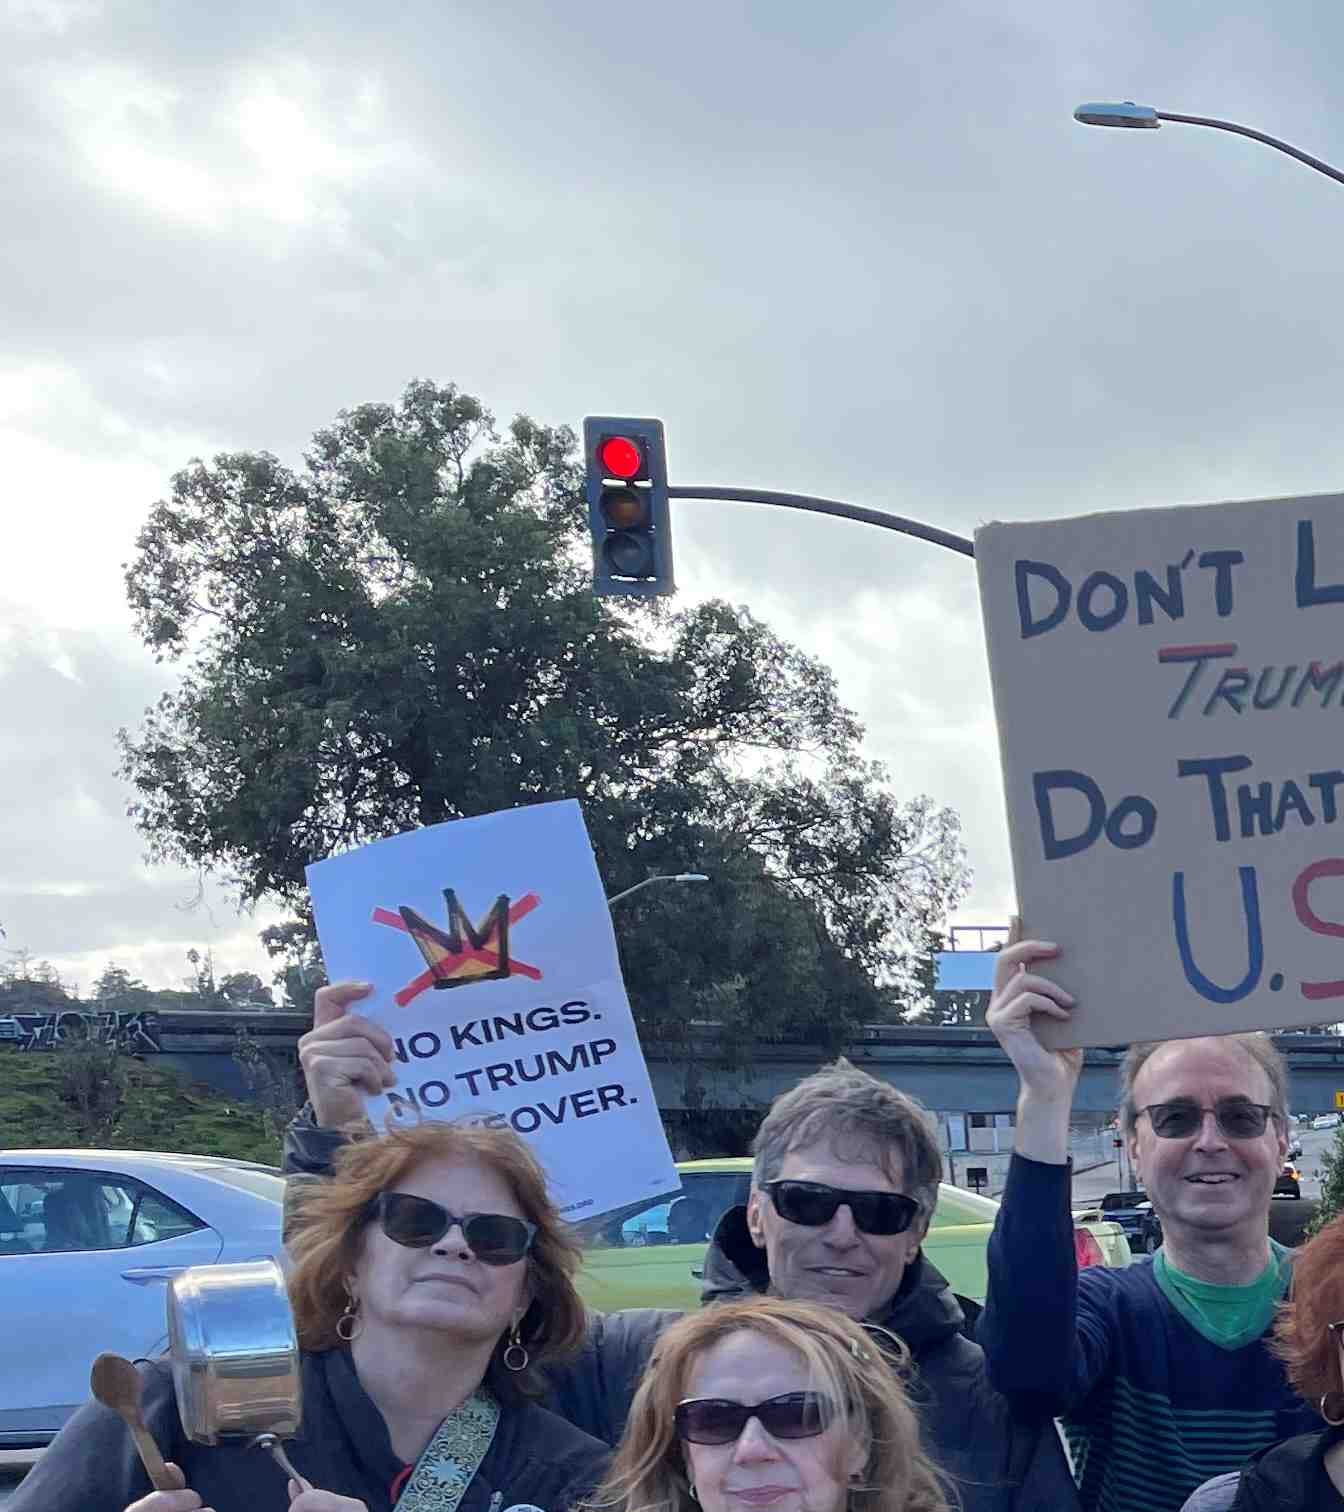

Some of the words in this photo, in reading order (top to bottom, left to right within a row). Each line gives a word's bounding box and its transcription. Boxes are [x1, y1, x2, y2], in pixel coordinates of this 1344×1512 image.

[1014, 549, 1245, 639] DON'T
[450, 1001, 601, 1049] KINGS.
[387, 1080, 450, 1117] NO
[455, 1038, 616, 1096] TRUMP
